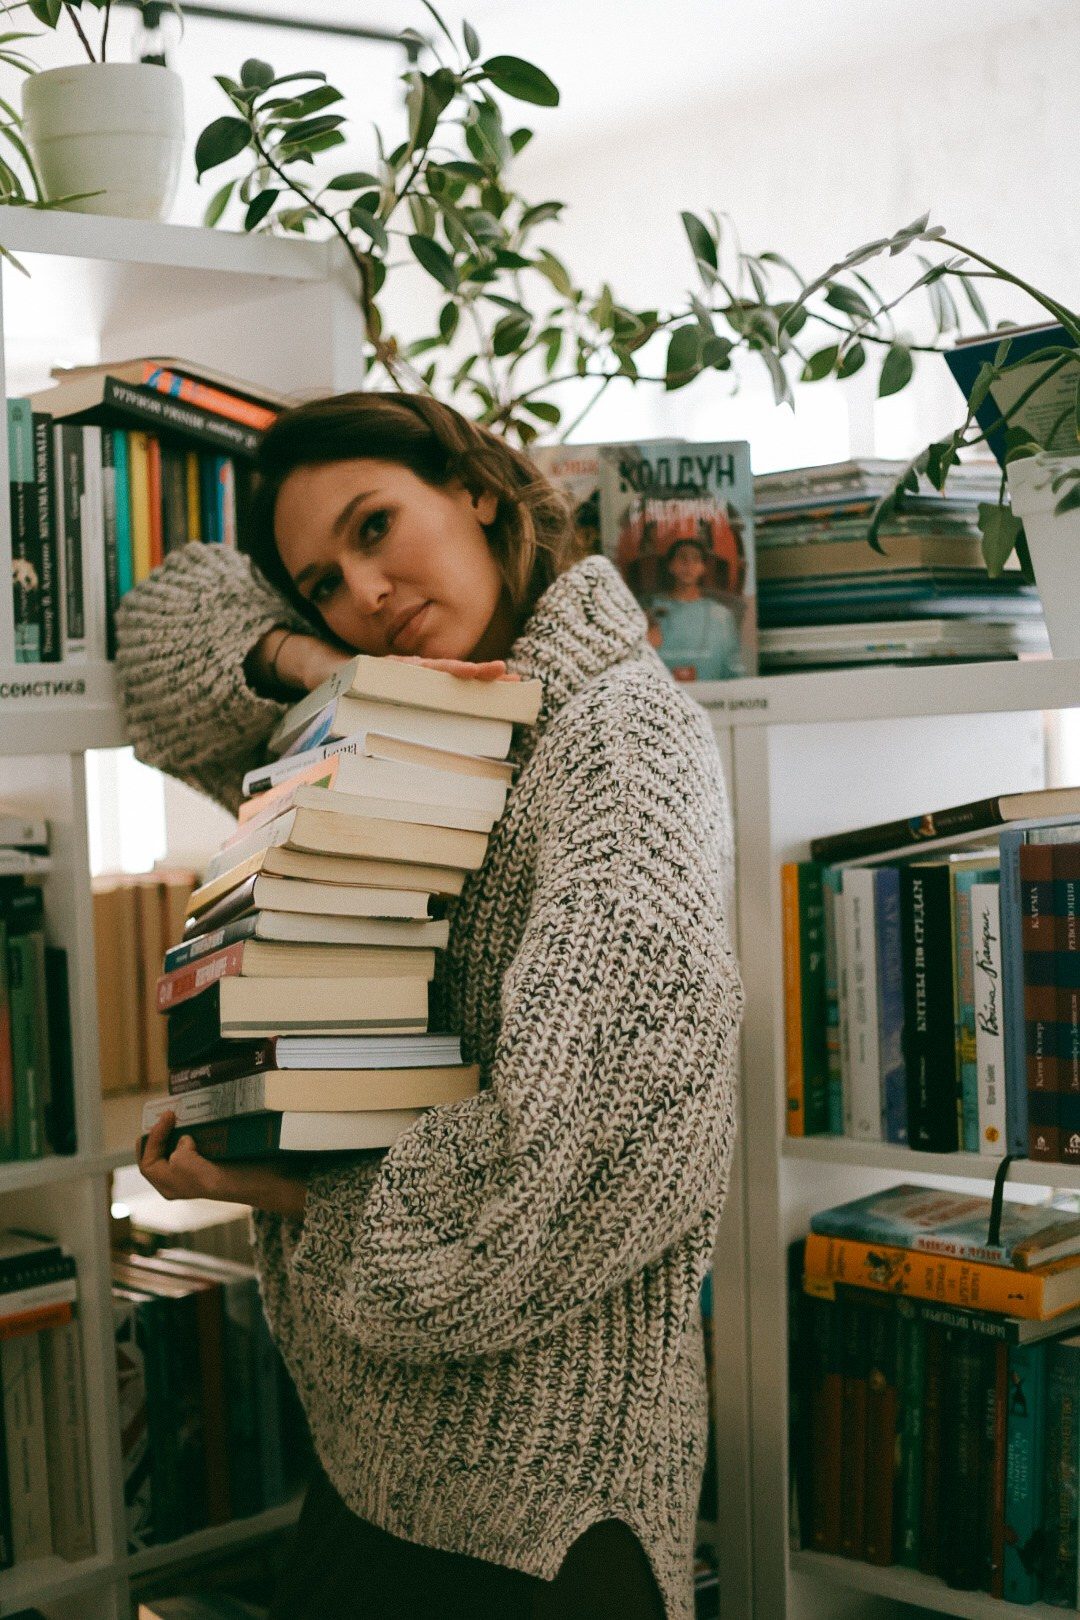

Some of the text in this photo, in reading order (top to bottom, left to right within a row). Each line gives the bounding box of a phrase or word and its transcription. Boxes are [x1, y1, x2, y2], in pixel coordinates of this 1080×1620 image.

[913, 879, 927, 1032] БИТВЫ ПО СРЕДАМ
[1030, 887, 1040, 930] КАРМА
[1066, 882, 1076, 951] РЕВОЛЮЦИЯ
[975, 906, 999, 1037] Война Катрин
